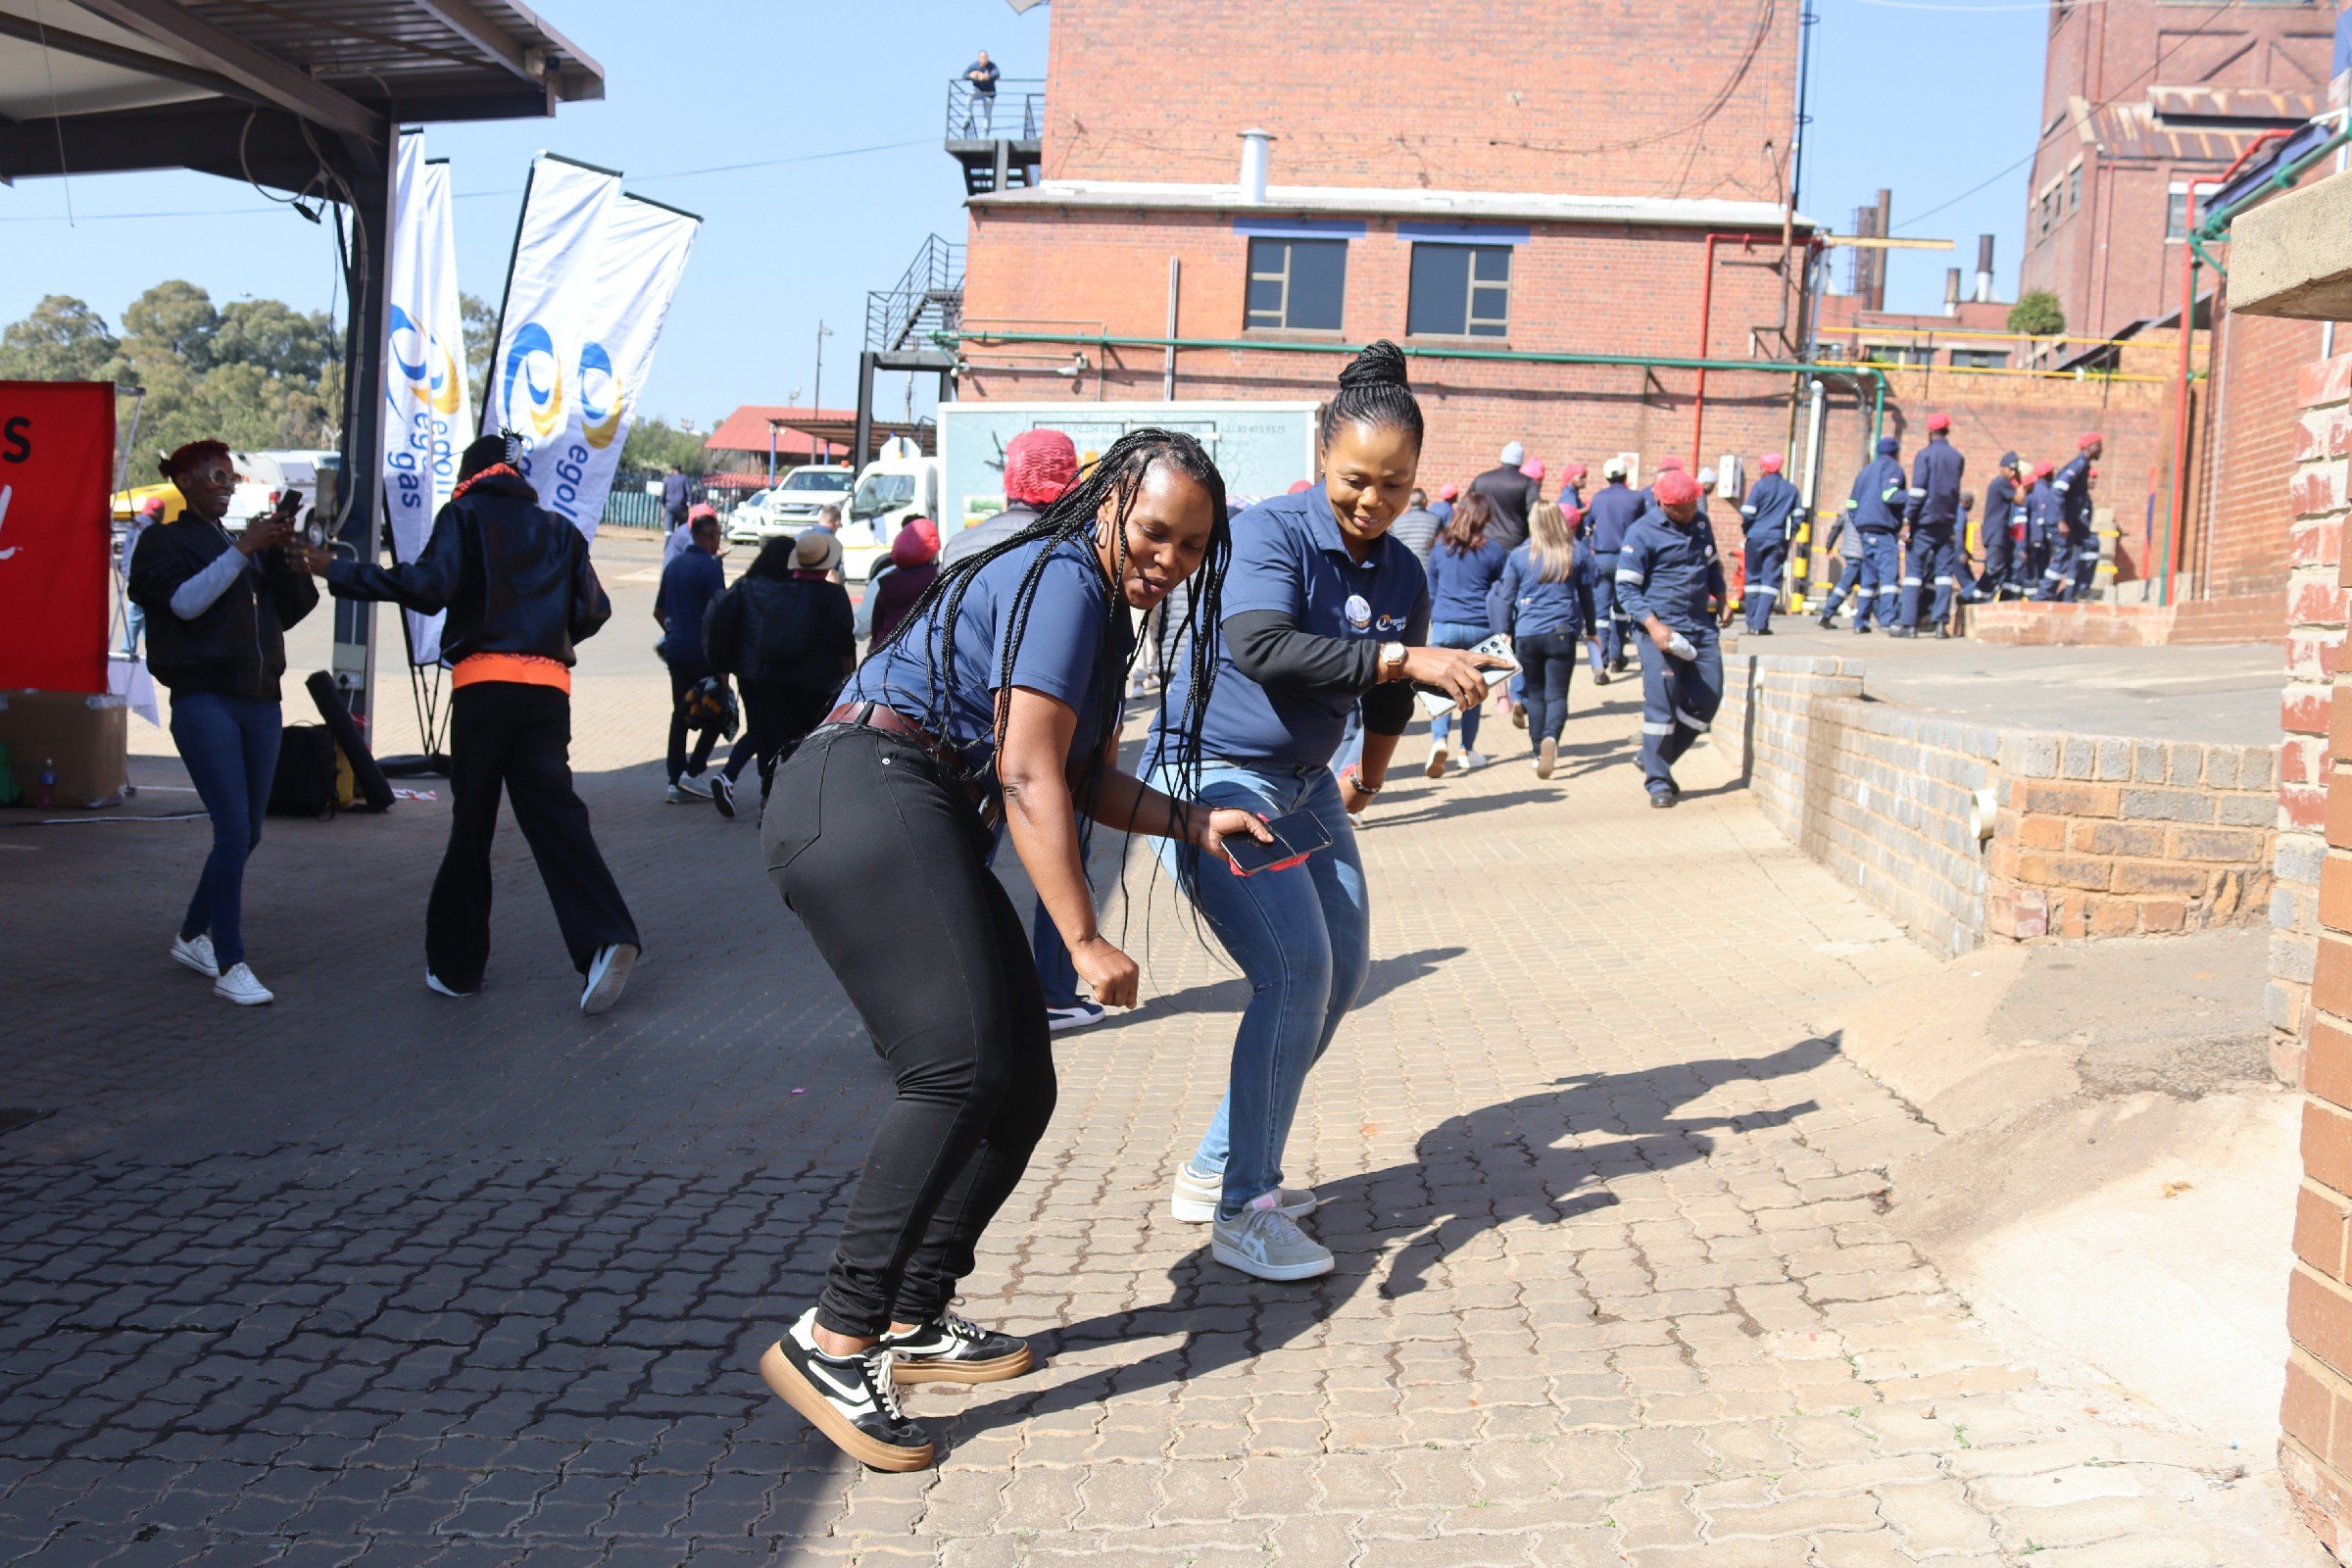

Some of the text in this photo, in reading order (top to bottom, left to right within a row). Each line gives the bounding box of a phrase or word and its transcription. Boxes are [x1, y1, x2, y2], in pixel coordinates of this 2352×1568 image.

[388, 452, 420, 508] gas
[554, 445, 588, 518] egol
[1396, 623, 1407, 632] ga
